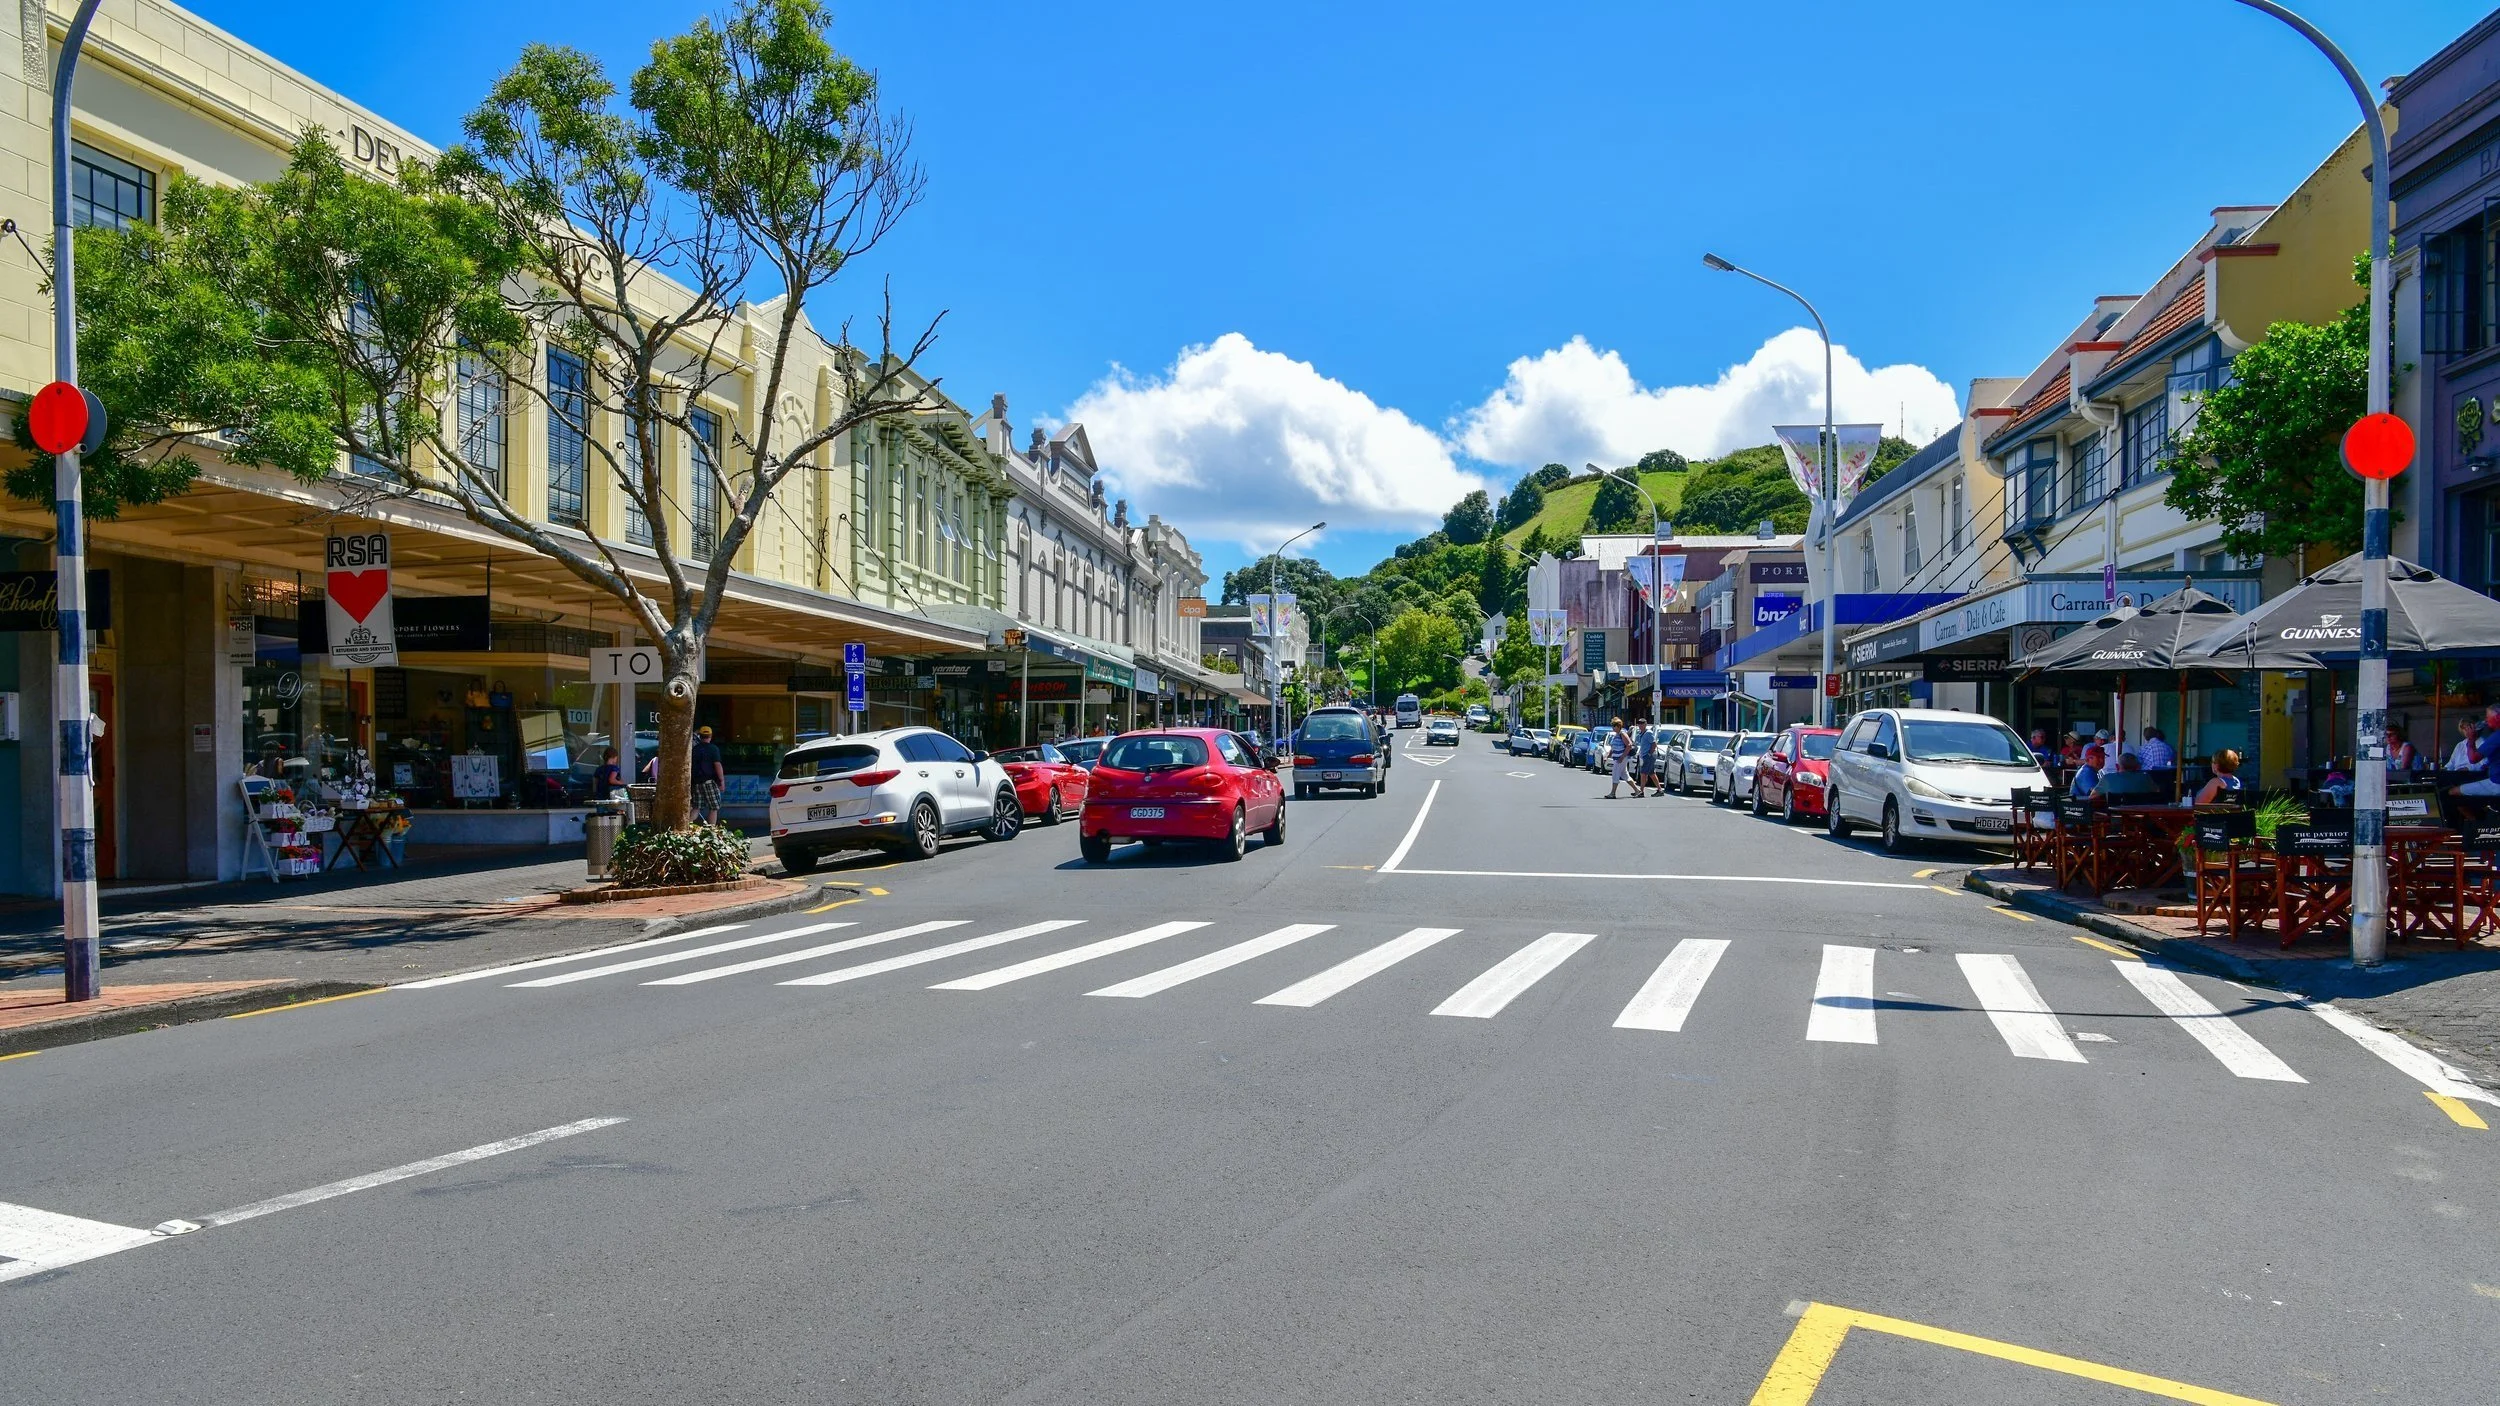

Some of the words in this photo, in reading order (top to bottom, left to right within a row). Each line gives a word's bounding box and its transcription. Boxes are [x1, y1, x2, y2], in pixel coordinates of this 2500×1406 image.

[327, 534, 388, 568] RSA
[1757, 606, 1789, 622] bnz
[423, 624, 460, 632] FLOWERS
[1934, 620, 1957, 641] Carram
[1966, 610, 1980, 632] Deli
[1981, 605, 1987, 628] &
[1856, 640, 1878, 663] SIERRA
[2092, 650, 2146, 660] GUINNESS
[609, 652, 661, 676] TO
[1952, 659, 2008, 672] SIERRA
[1772, 679, 1789, 688] bnz
